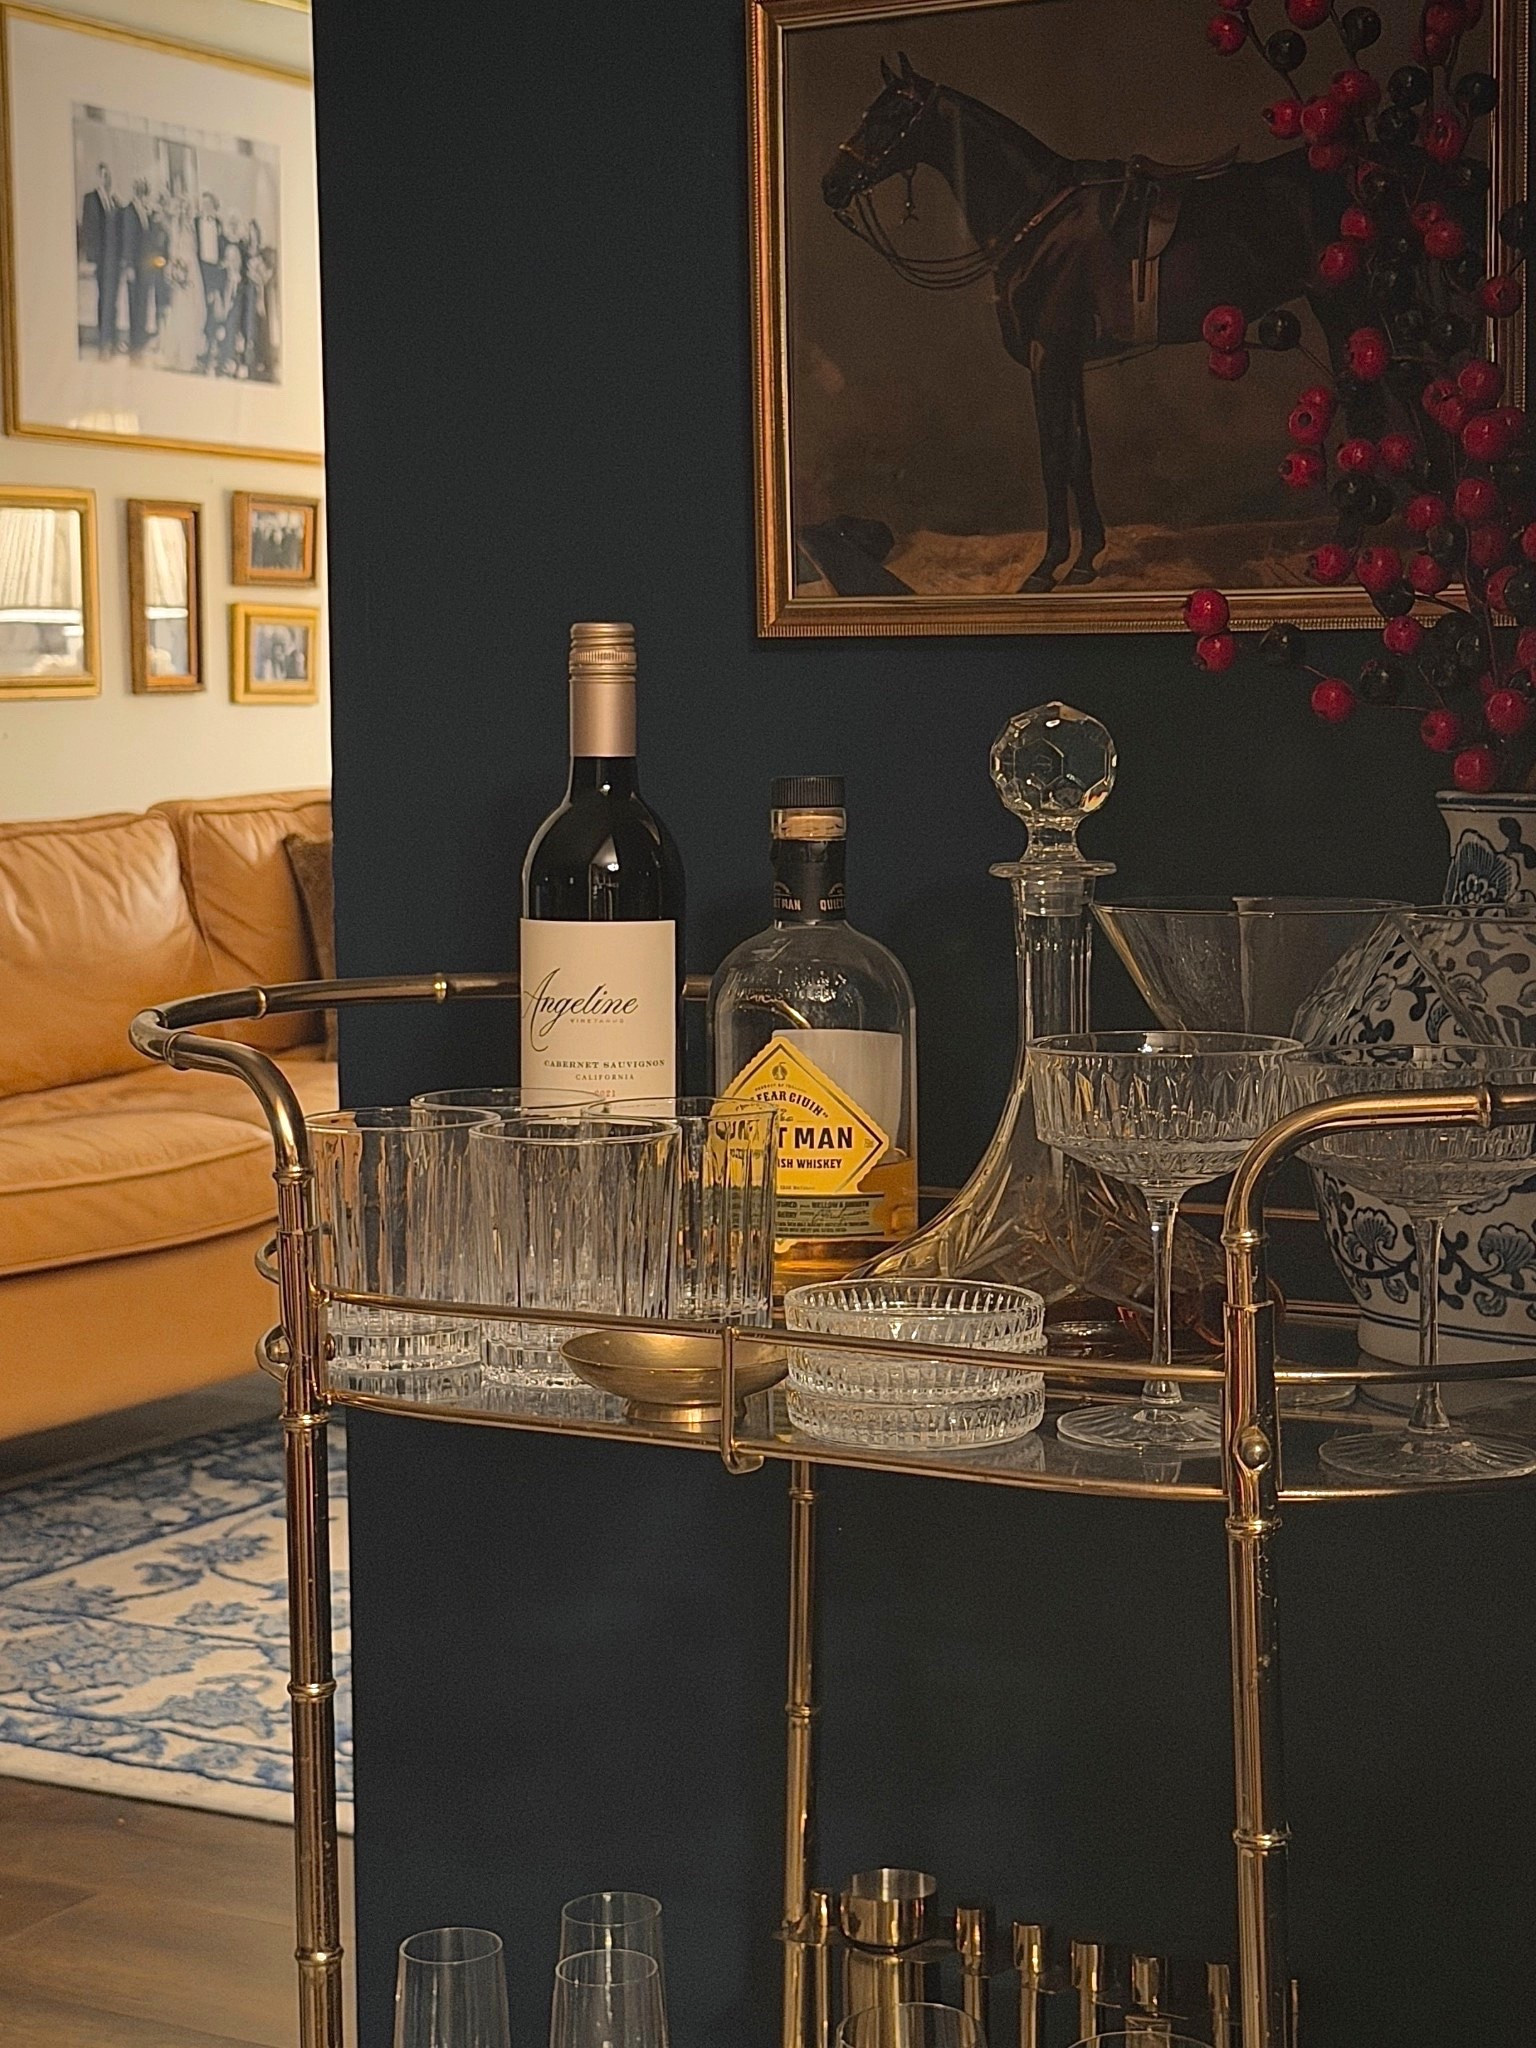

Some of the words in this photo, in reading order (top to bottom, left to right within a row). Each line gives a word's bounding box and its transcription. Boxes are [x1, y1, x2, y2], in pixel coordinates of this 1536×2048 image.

[523, 967, 639, 1052] Angeline
[543, 1060, 600, 1069] CABERNET
[603, 1059, 666, 1069] SAUVIGNON
[756, 1090, 787, 1103] FEAR
[794, 1127, 853, 1149] MAN
[796, 1158, 843, 1169] WHISKEY
